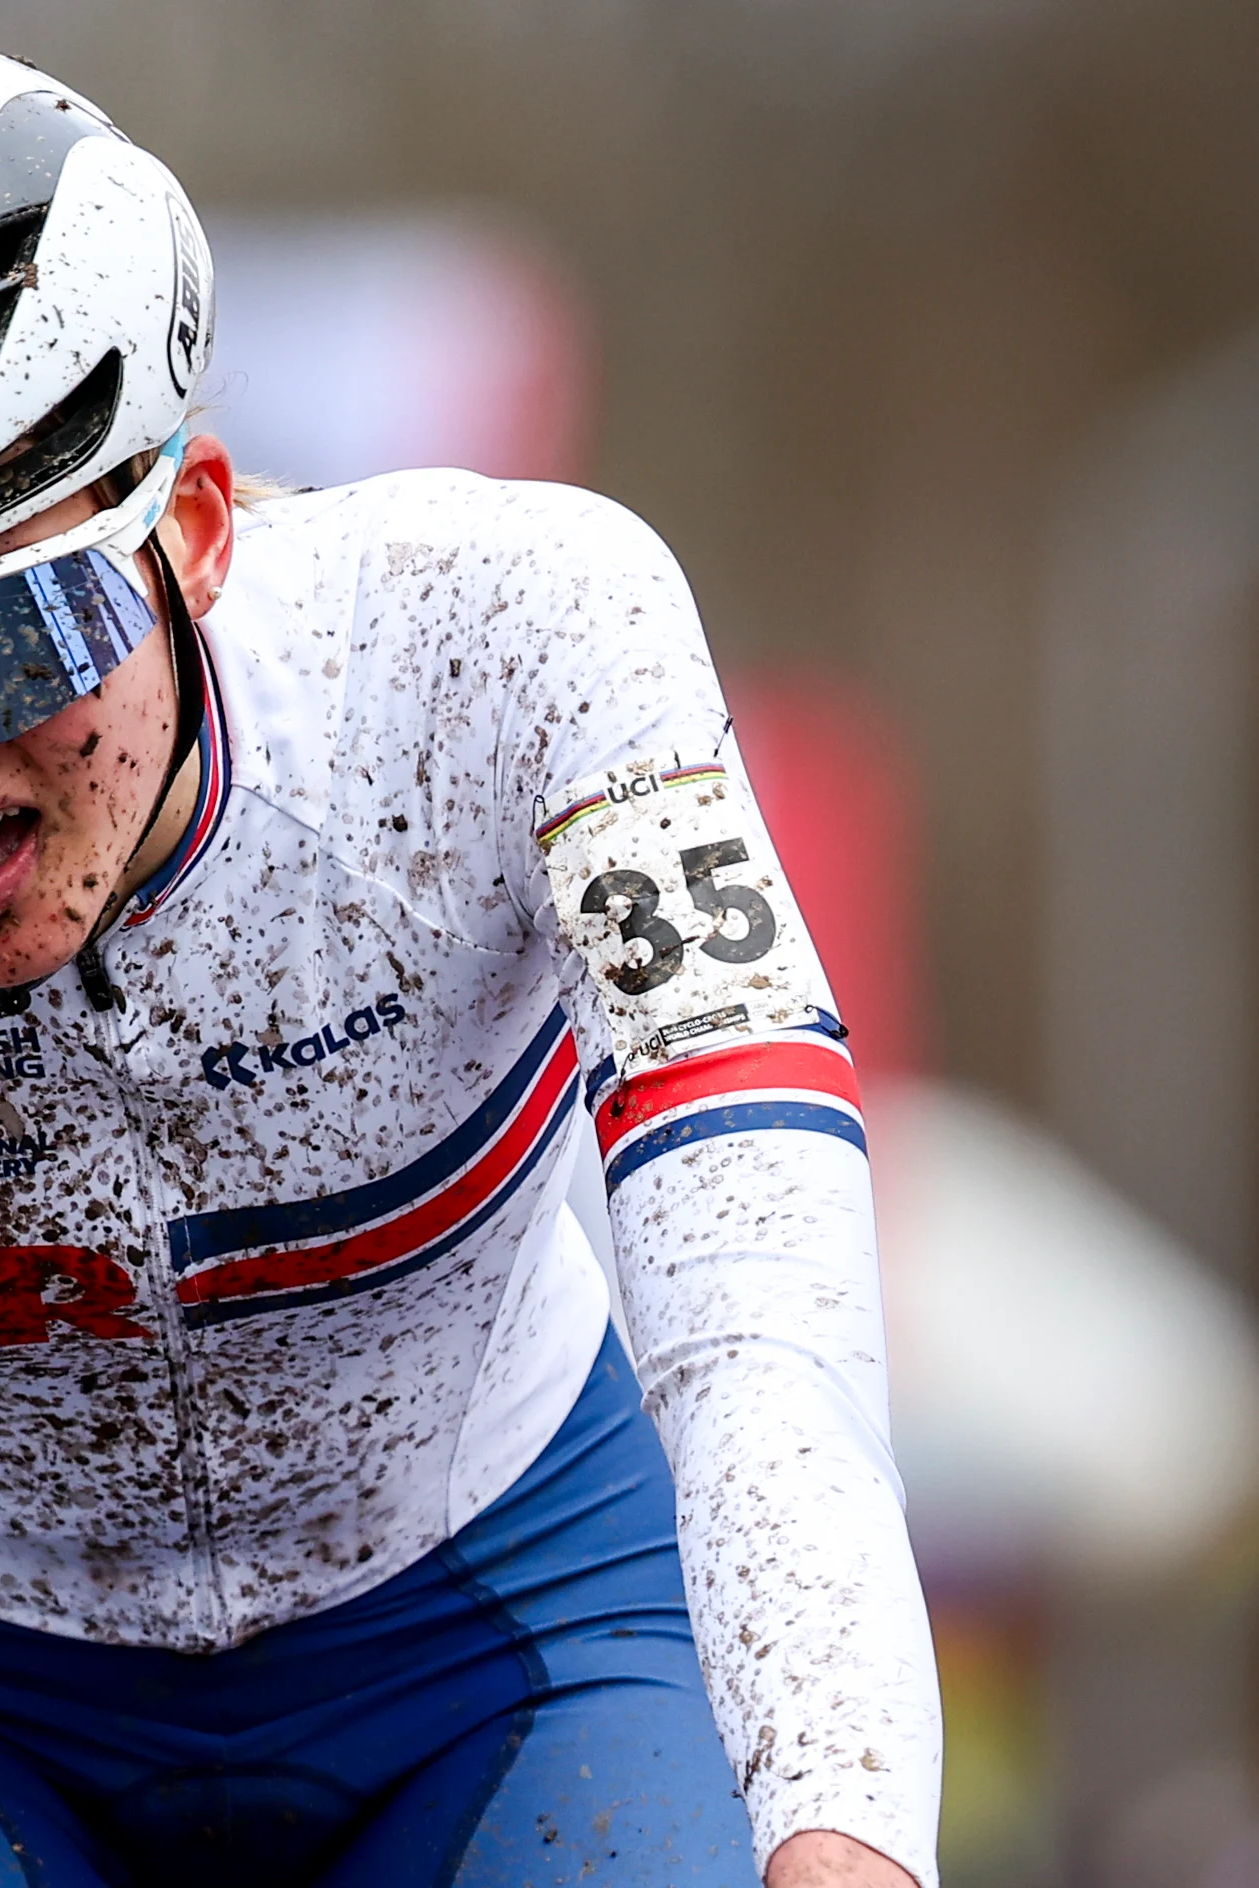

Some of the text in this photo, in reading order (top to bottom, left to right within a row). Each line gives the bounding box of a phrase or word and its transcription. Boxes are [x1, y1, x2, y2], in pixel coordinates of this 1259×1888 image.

[606, 774, 659, 804] UCI
[581, 836, 777, 996] 35
[640, 1033, 661, 1056] UCI
